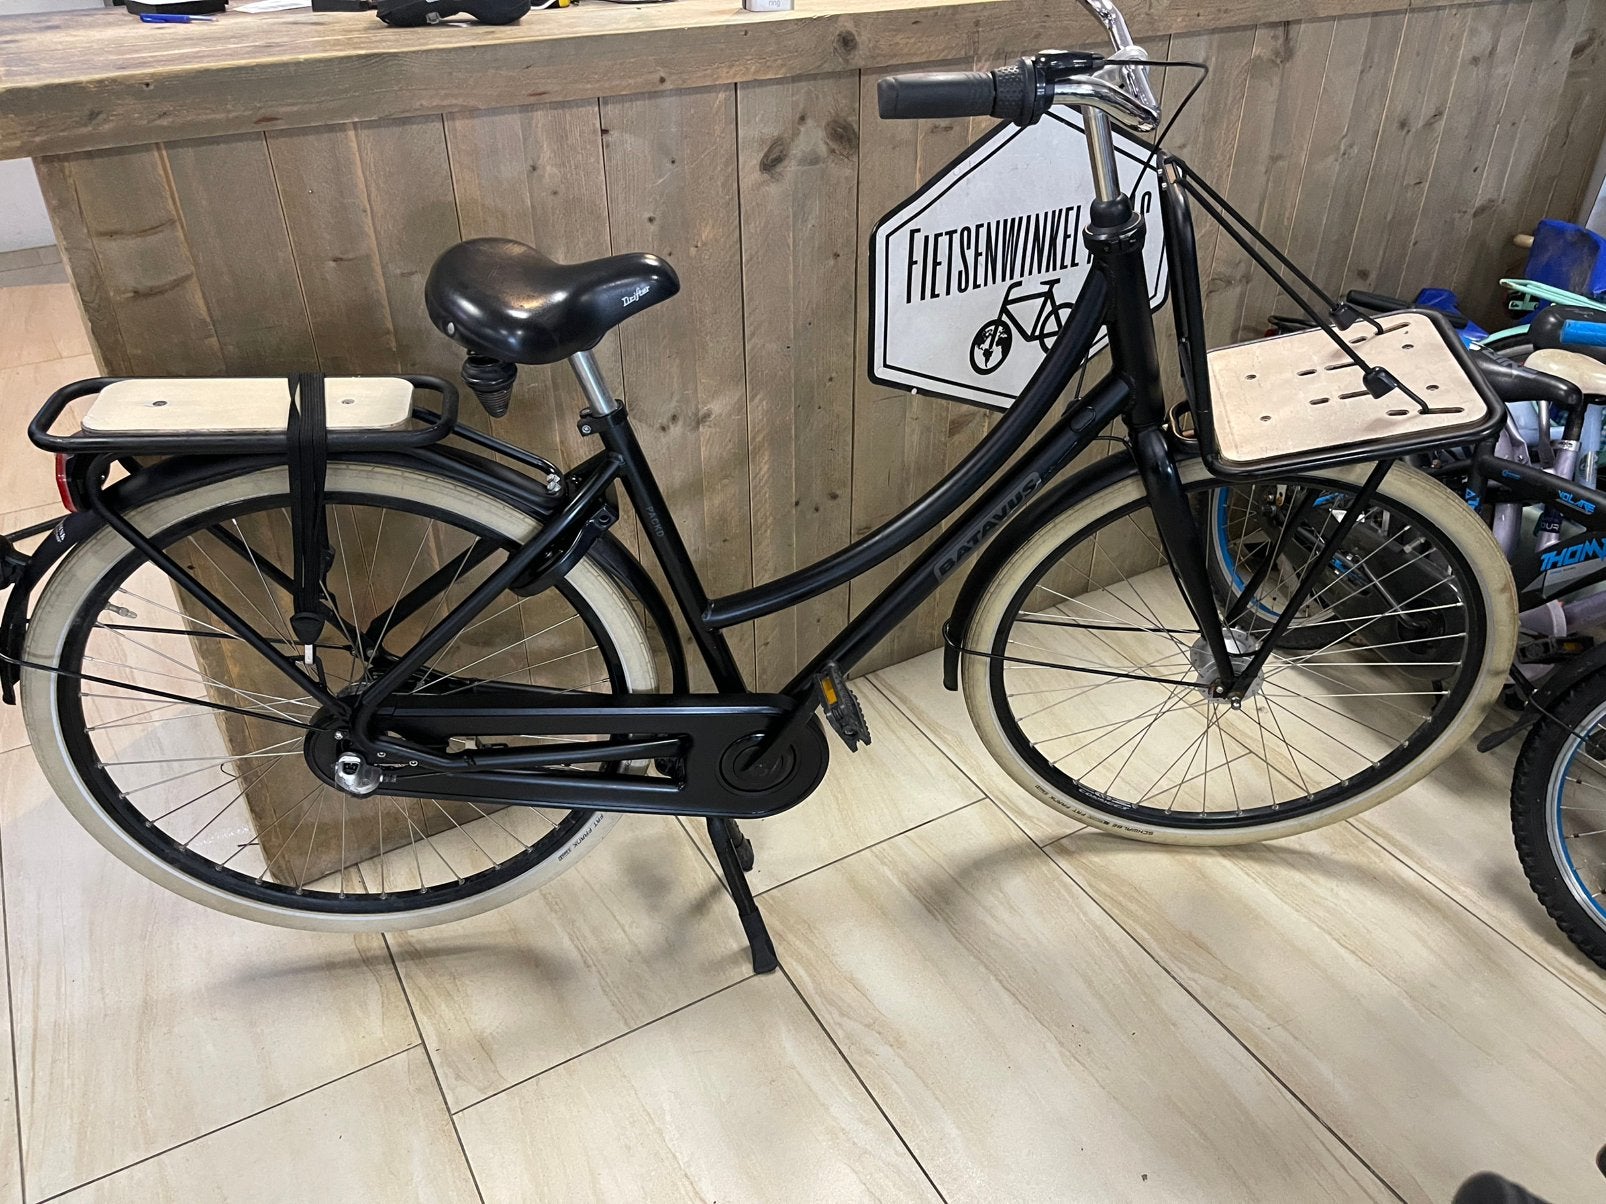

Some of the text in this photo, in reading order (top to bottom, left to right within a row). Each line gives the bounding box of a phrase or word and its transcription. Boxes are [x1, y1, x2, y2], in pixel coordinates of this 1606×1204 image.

[906, 205, 1082, 304] FIETSENWINKEL
[621, 285, 650, 307] Drifter
[938, 478, 1037, 576] BATAVUS
[1540, 537, 1606, 572] THOM
